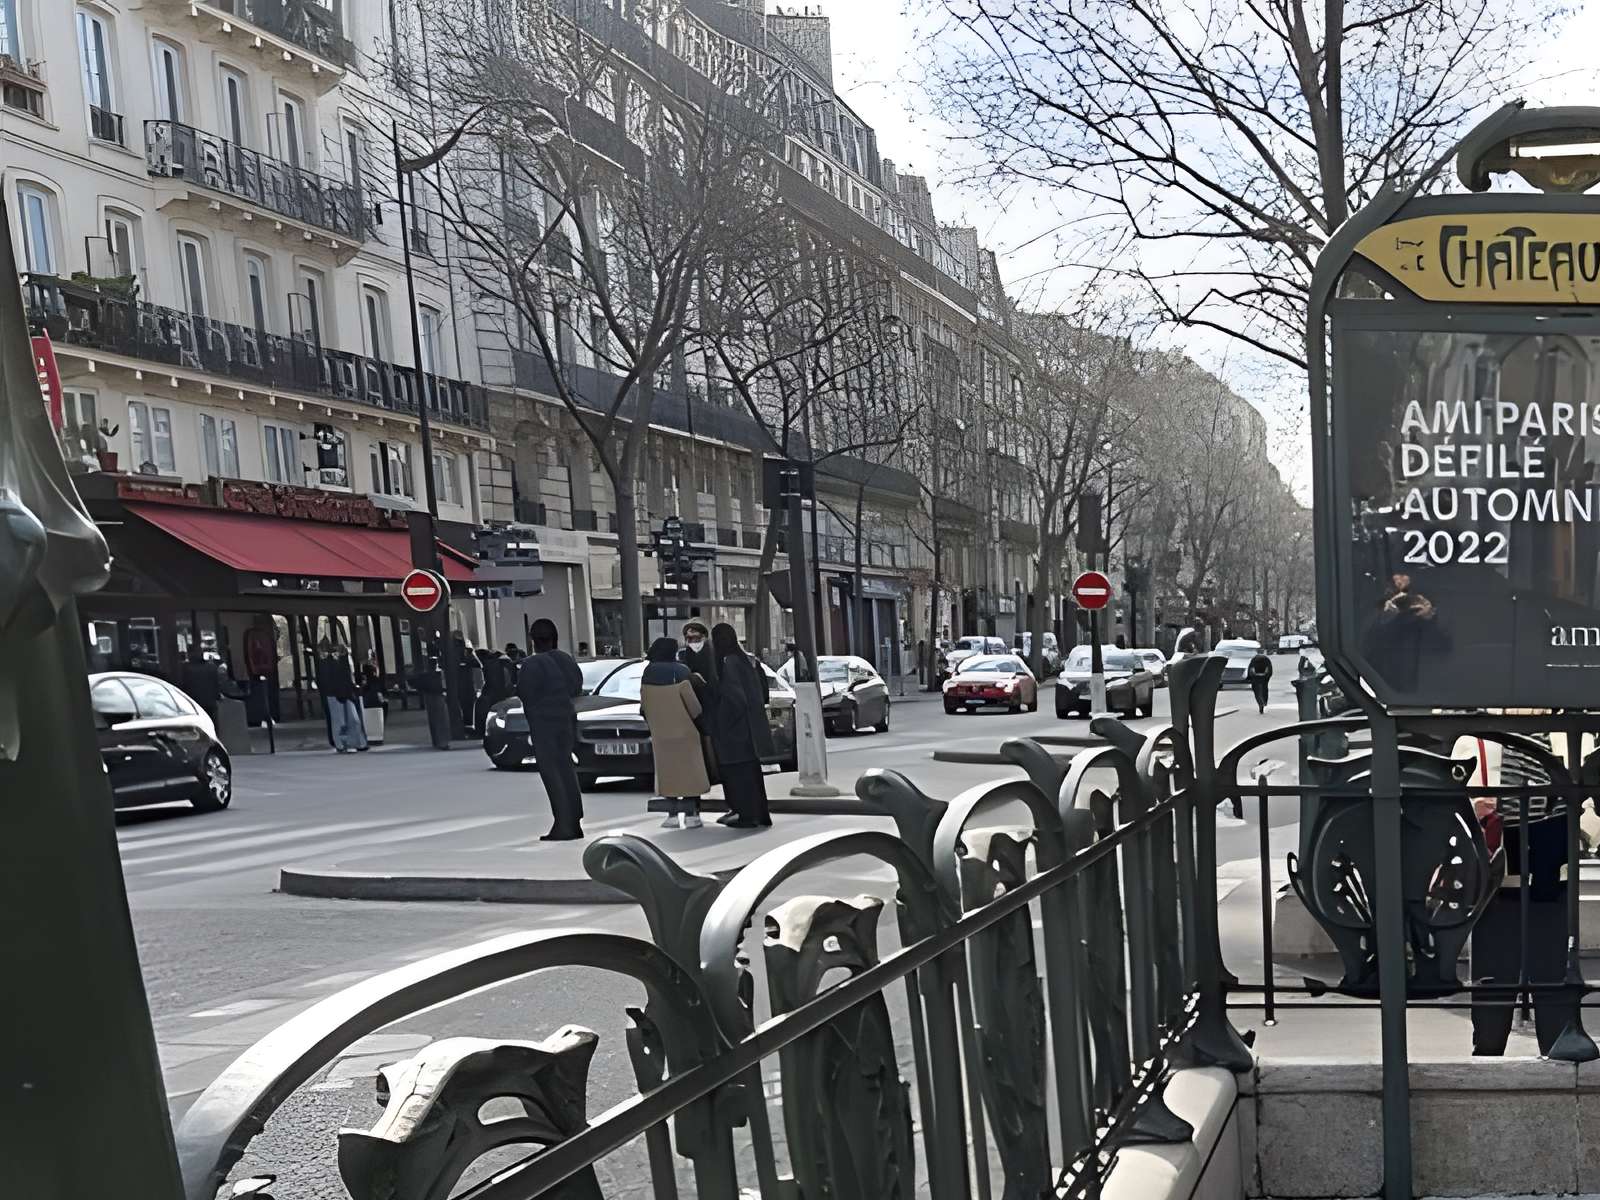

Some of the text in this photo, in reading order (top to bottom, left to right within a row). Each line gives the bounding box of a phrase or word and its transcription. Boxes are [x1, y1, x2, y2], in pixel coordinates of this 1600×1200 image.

[1401, 399, 1482, 435] AMI
[1401, 436, 1546, 479] DÉFILÉ
[1403, 530, 1509, 566] 2022
